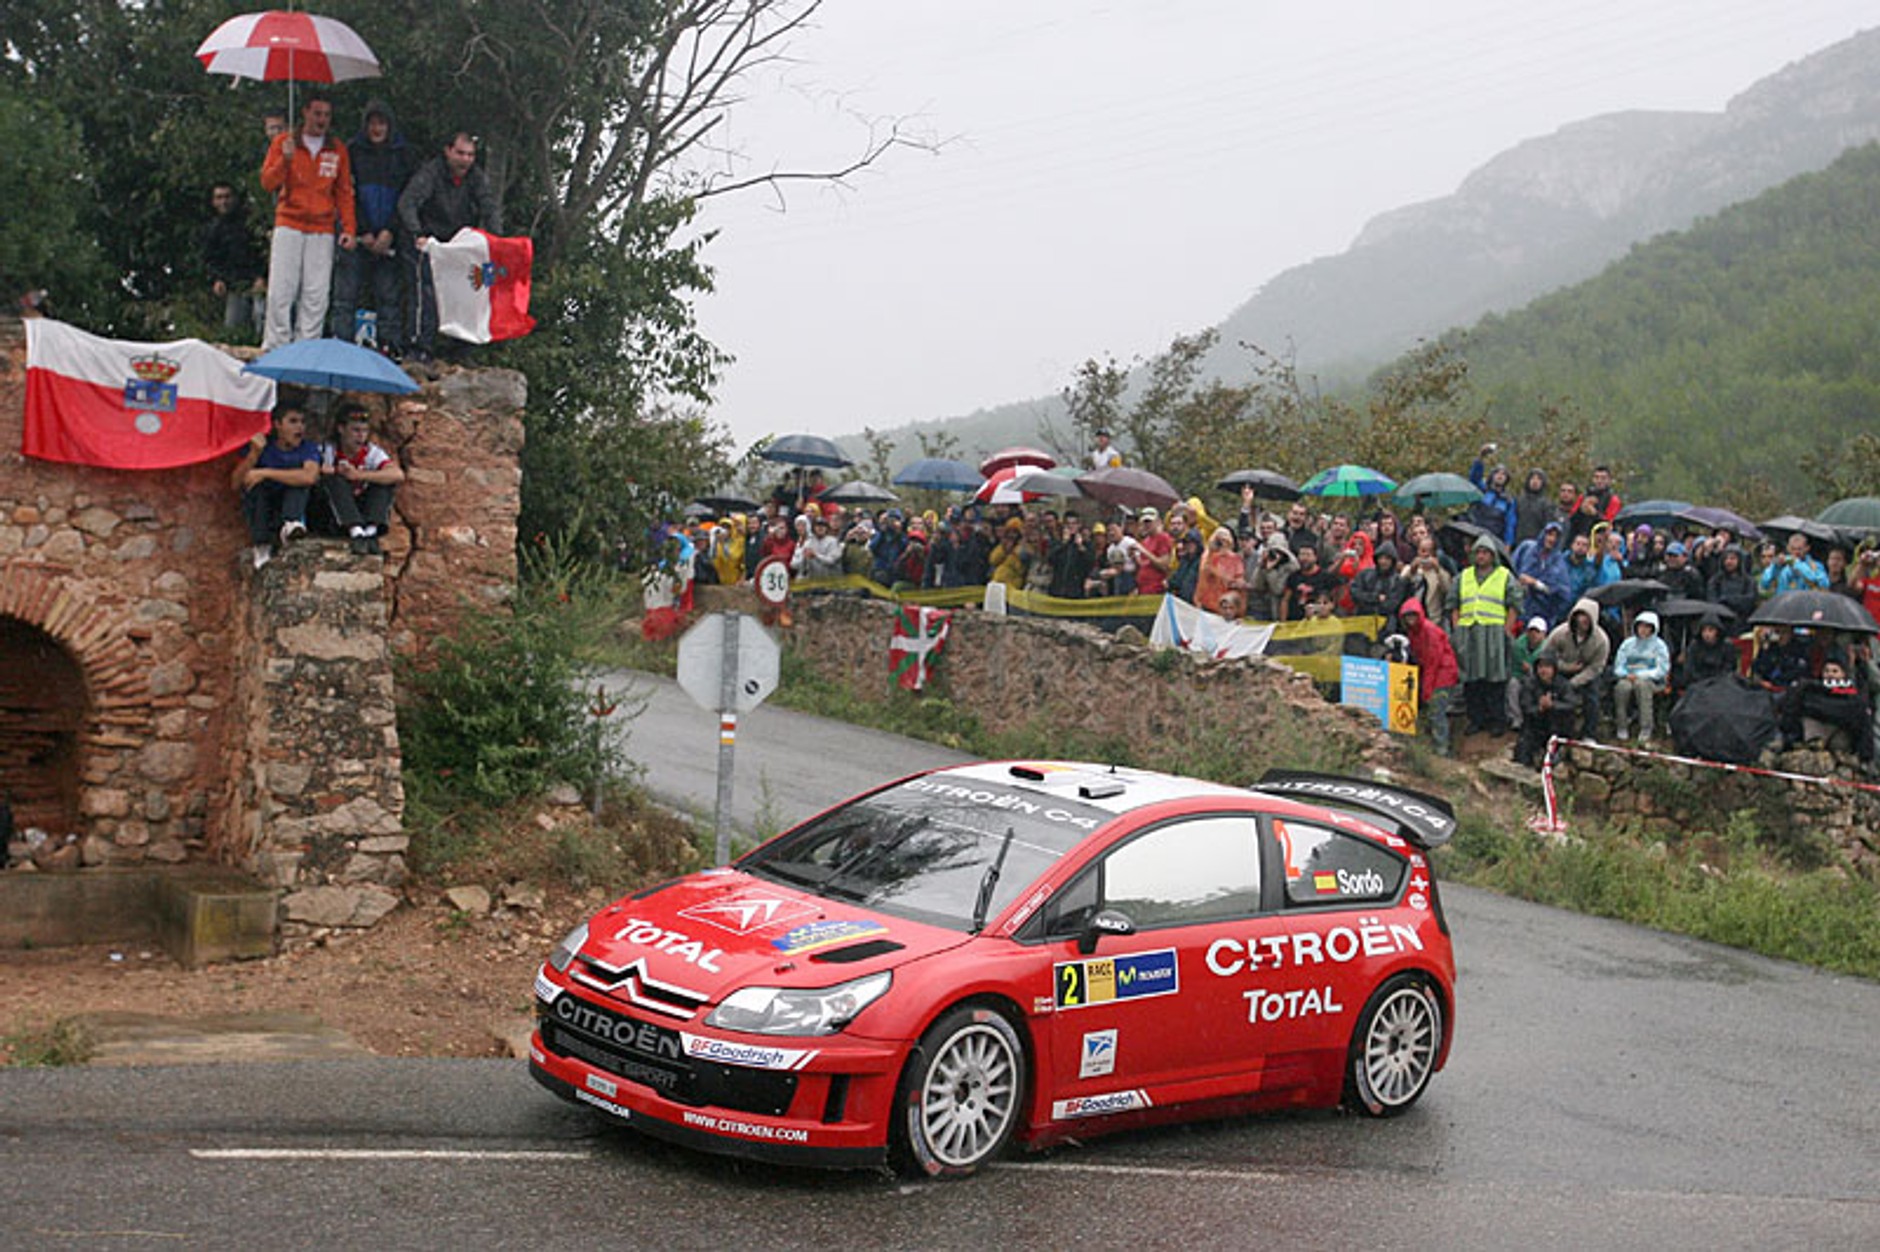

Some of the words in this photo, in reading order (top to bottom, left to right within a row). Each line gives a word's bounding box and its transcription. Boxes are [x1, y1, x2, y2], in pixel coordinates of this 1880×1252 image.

[902, 780, 1041, 814] CITROËN
[1045, 808, 1099, 829] C4
[1402, 804, 1447, 829] C4
[1337, 868, 1383, 894] Sordo
[613, 918, 723, 973] TOTAL
[1205, 916, 1424, 976] CITROËN
[1062, 965, 1078, 1004] 2
[1243, 986, 1343, 1023] TOTAL
[556, 997, 681, 1058] CITROËN
[690, 1038, 785, 1063] BFGoodrich
